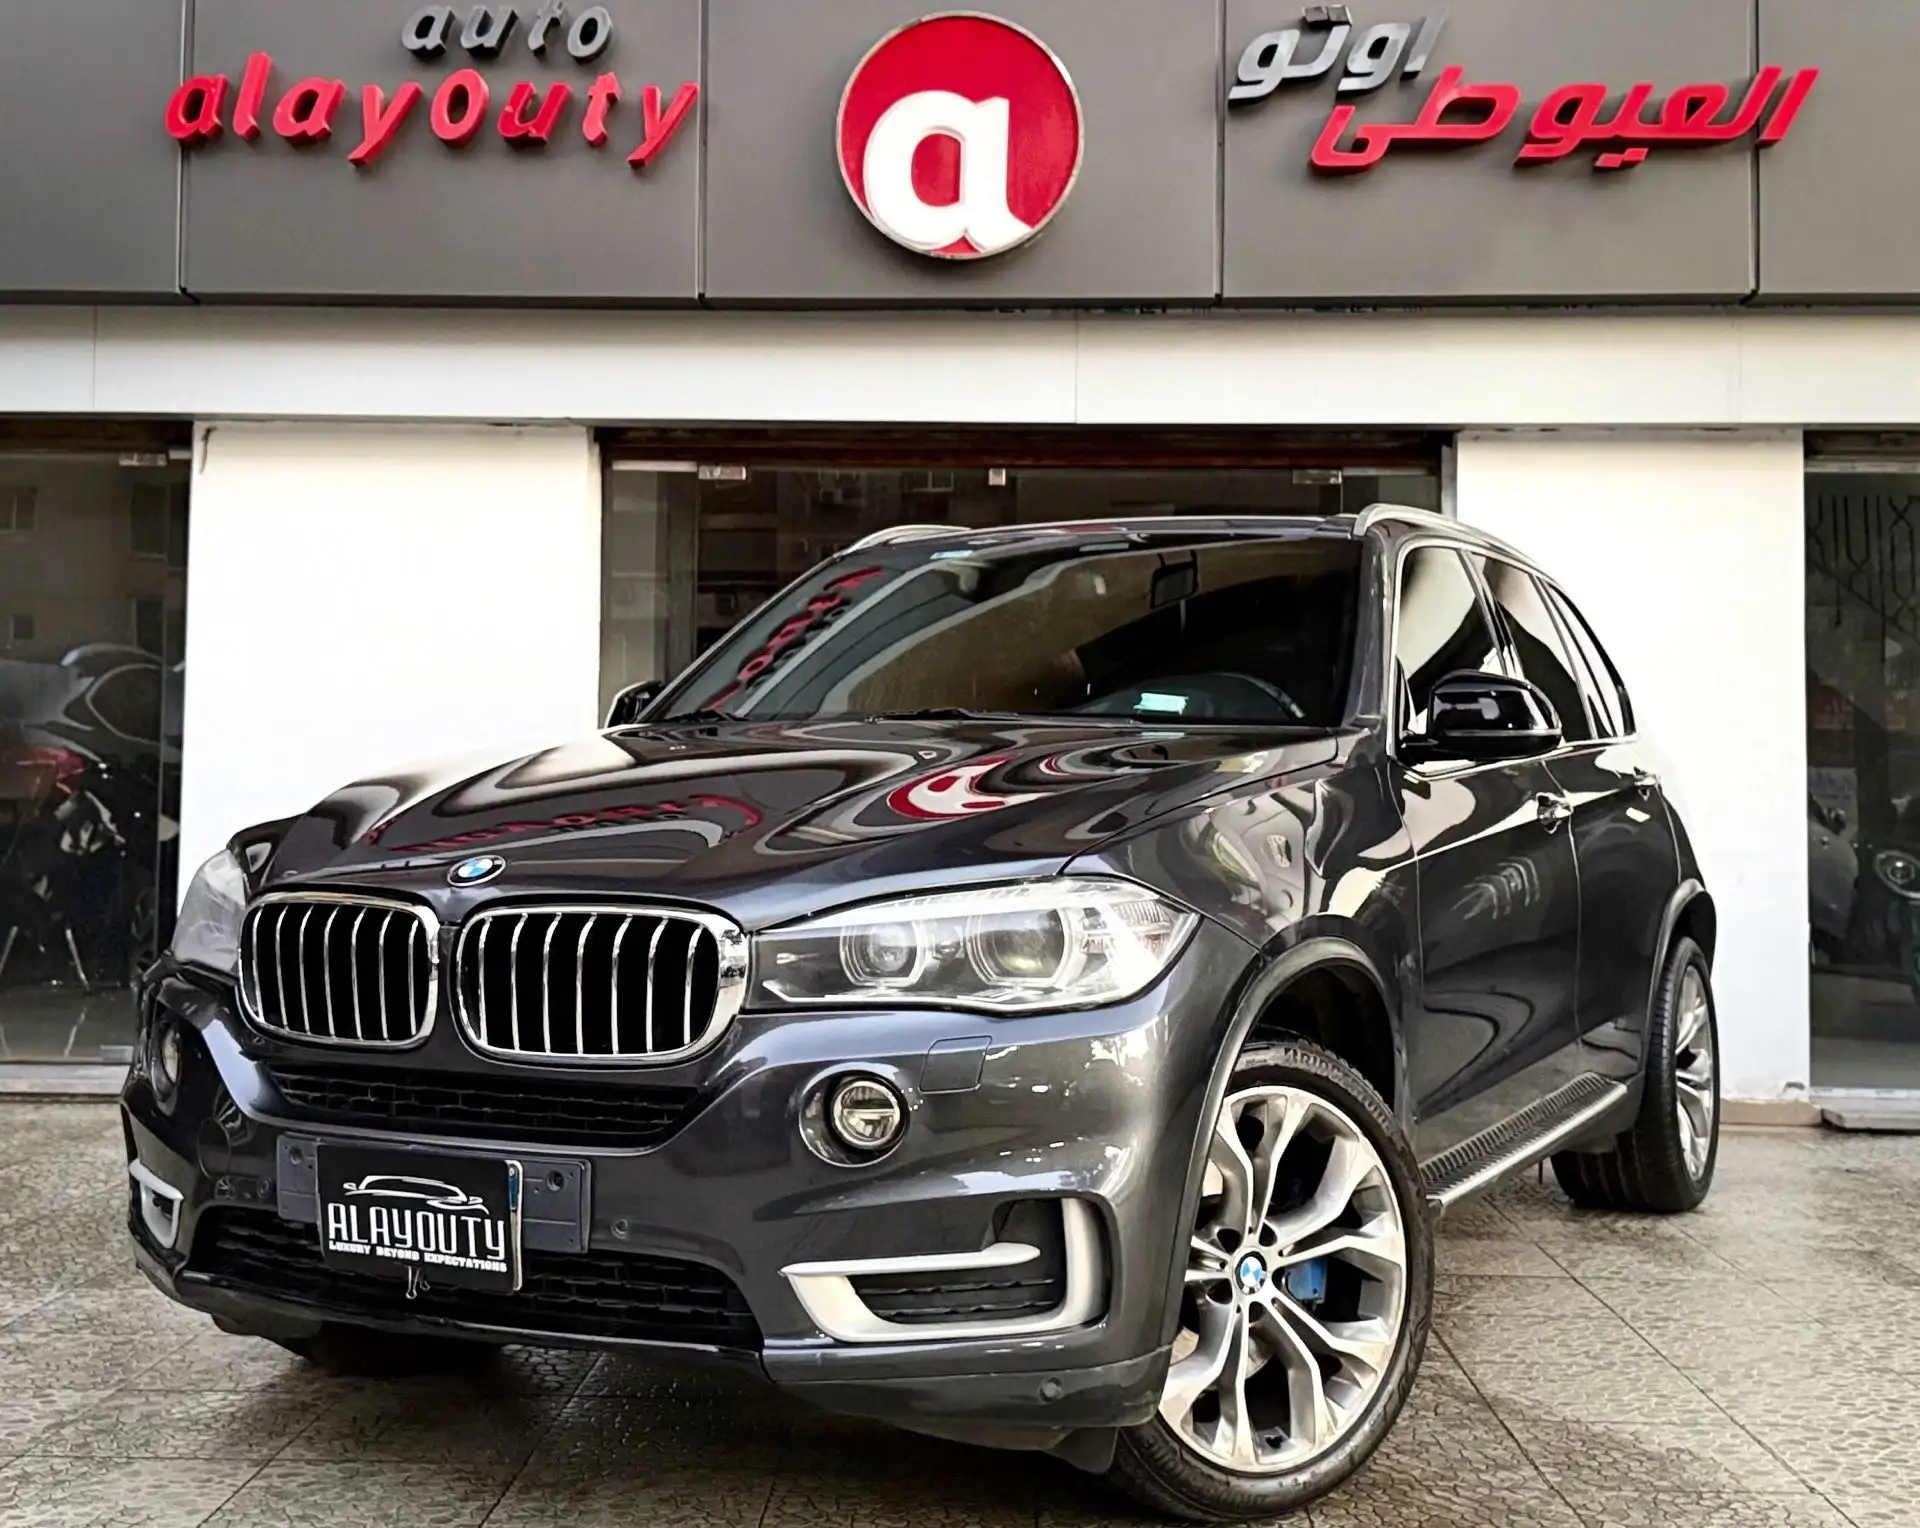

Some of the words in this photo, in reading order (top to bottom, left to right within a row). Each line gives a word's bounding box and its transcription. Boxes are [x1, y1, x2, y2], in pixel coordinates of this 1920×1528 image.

[402, 1, 613, 62] auto
[327, 1202, 506, 1261] ALAYOUTY
[329, 1240, 371, 1255] LUXURY
[376, 1246, 420, 1261] BEYOND
[423, 1251, 508, 1273] EXPECTATIONS
